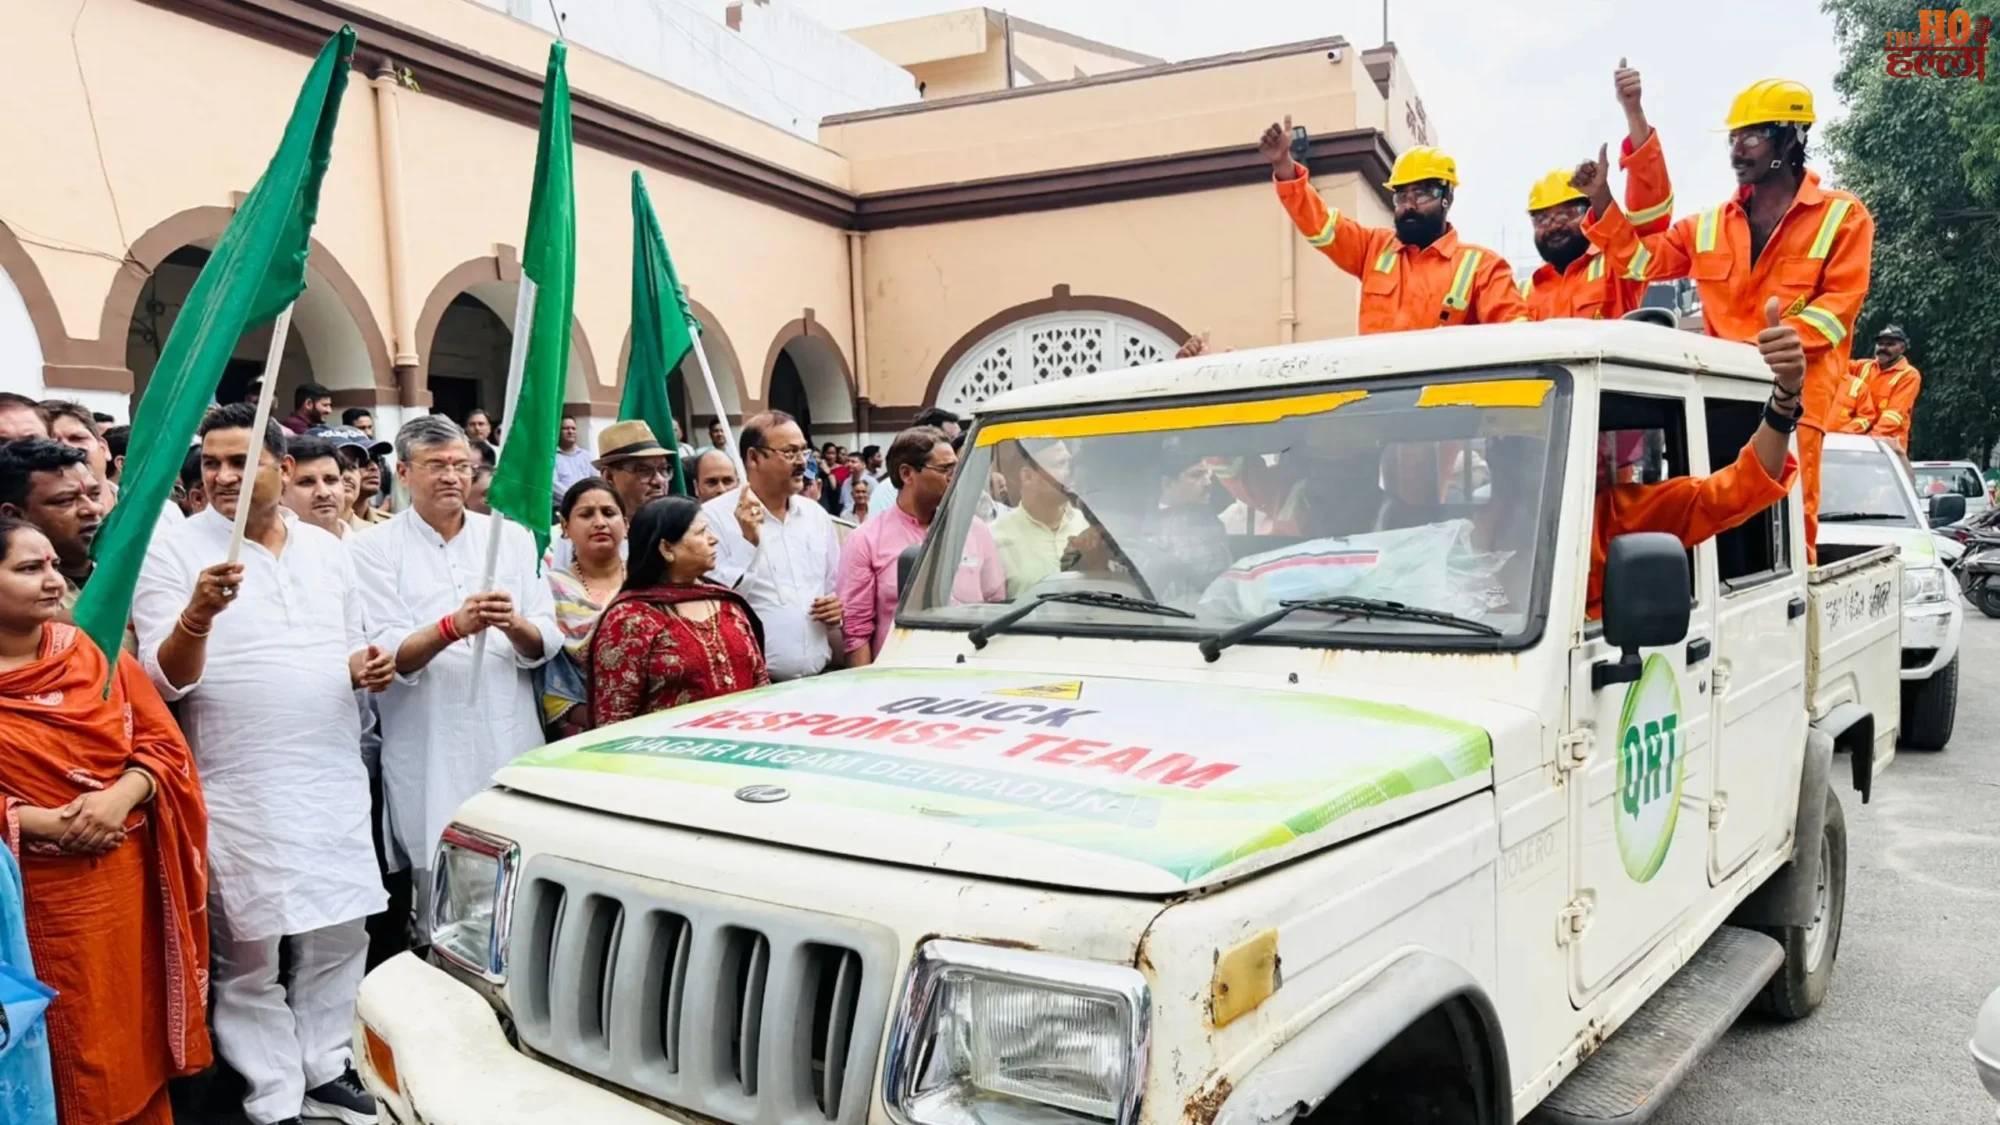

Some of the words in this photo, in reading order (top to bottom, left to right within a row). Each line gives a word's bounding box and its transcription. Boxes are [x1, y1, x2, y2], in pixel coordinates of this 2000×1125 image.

[673, 710, 1004, 750] RESPONSE
[1001, 733, 1240, 789] TEAM
[878, 696, 1101, 728] QUICK
[618, 738, 731, 757] NAGAR
[732, 748, 857, 770] NIGAM
[861, 759, 1122, 814] DEHRADUN
[1623, 714, 1677, 822] QRT
